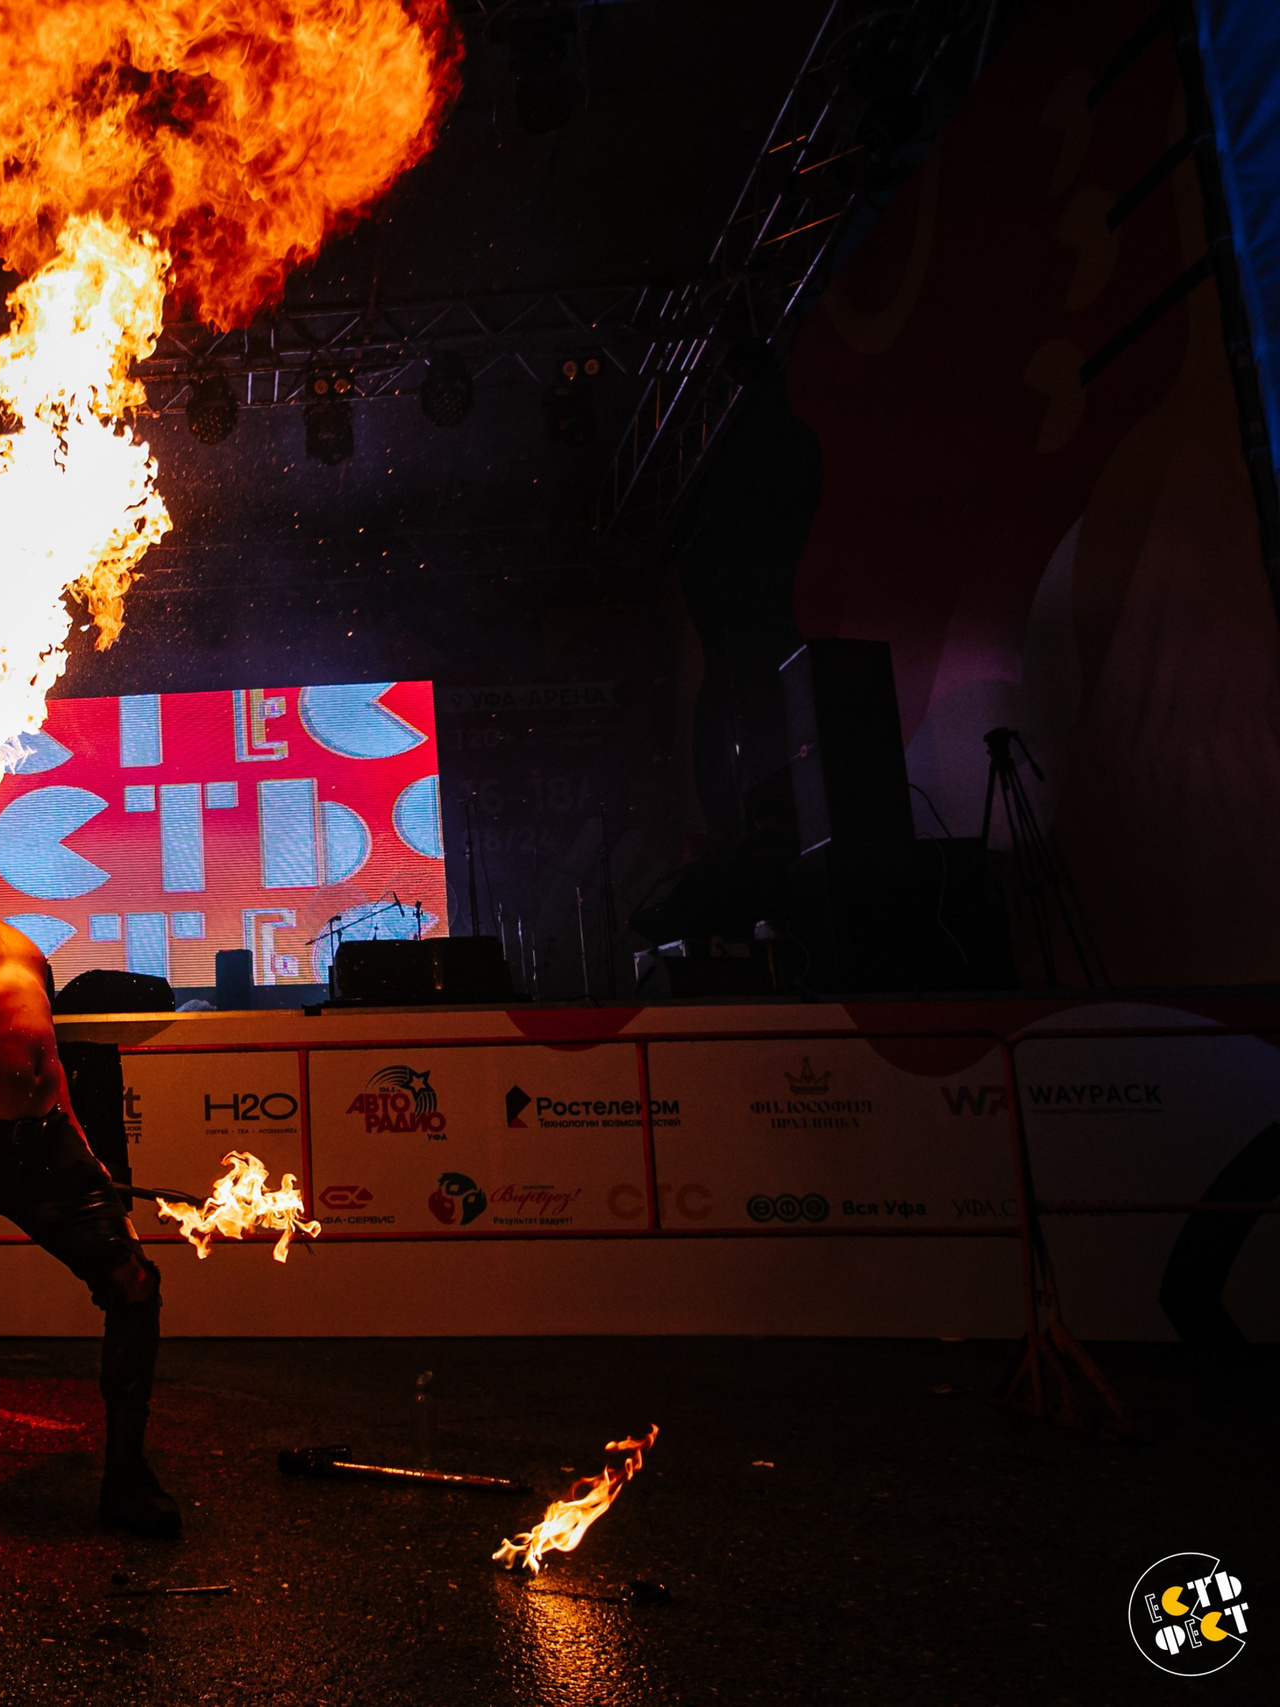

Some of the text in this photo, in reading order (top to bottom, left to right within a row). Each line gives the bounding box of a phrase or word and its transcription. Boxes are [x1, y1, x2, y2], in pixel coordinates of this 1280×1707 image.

[346, 1093, 411, 1114] АВТО
[1028, 1084, 1162, 1104] WAYPACK
[204, 1092, 298, 1122] H2O
[365, 1111, 447, 1133] РАДИО
[538, 1116, 681, 1129] Технологии возможостей
[427, 1133, 447, 1142] УФА
[842, 1199, 927, 1220] Вся Уфа
